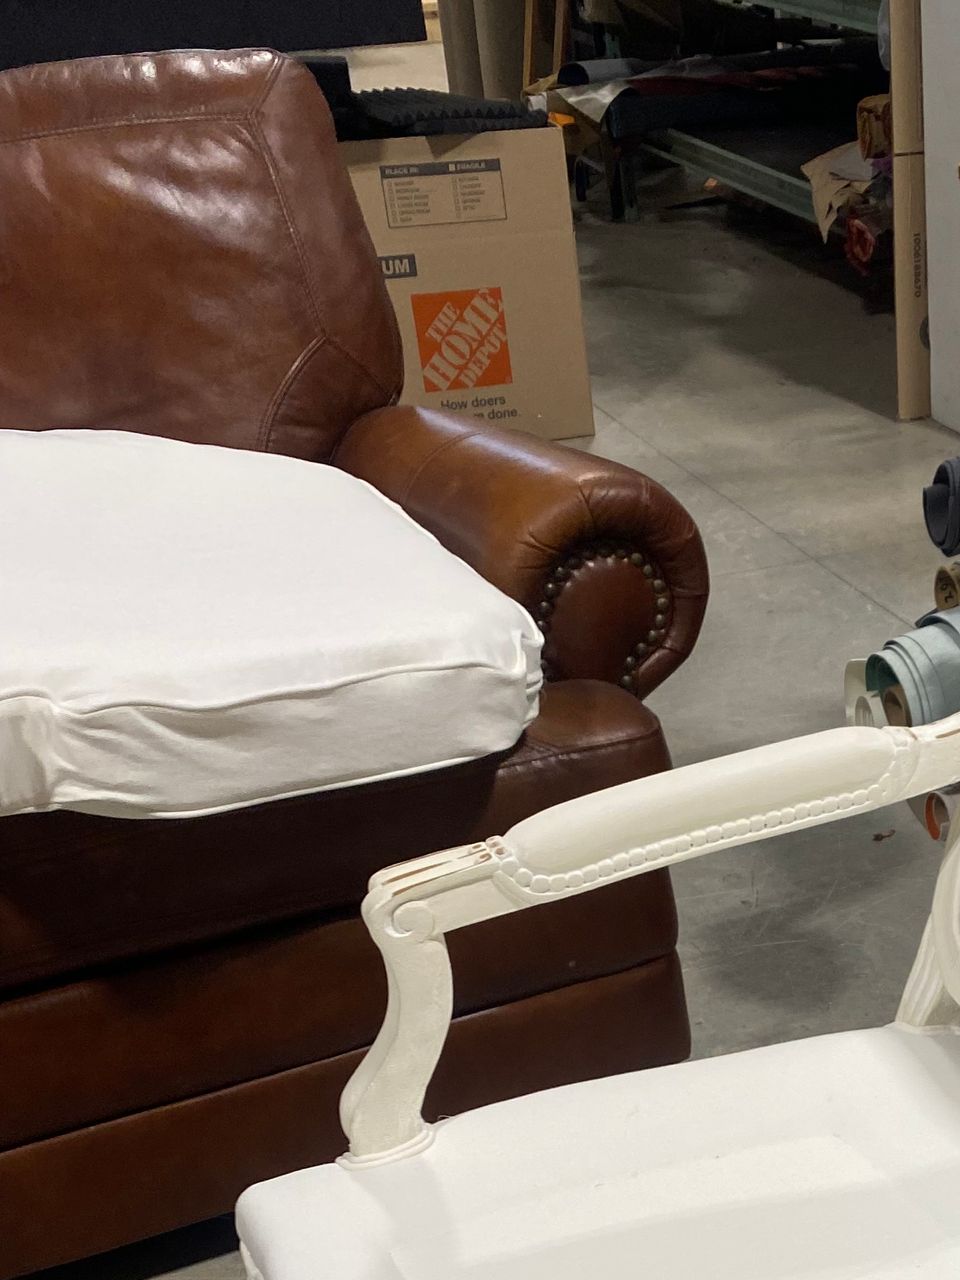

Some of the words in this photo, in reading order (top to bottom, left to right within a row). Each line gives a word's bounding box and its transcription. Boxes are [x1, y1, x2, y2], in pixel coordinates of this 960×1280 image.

[381, 258, 410, 275] UM
[423, 290, 502, 391] HOME
[425, 301, 460, 342] THE
[459, 323, 507, 388] DEPOT
[440, 399, 468, 411] How
[471, 396, 506, 408] doers
